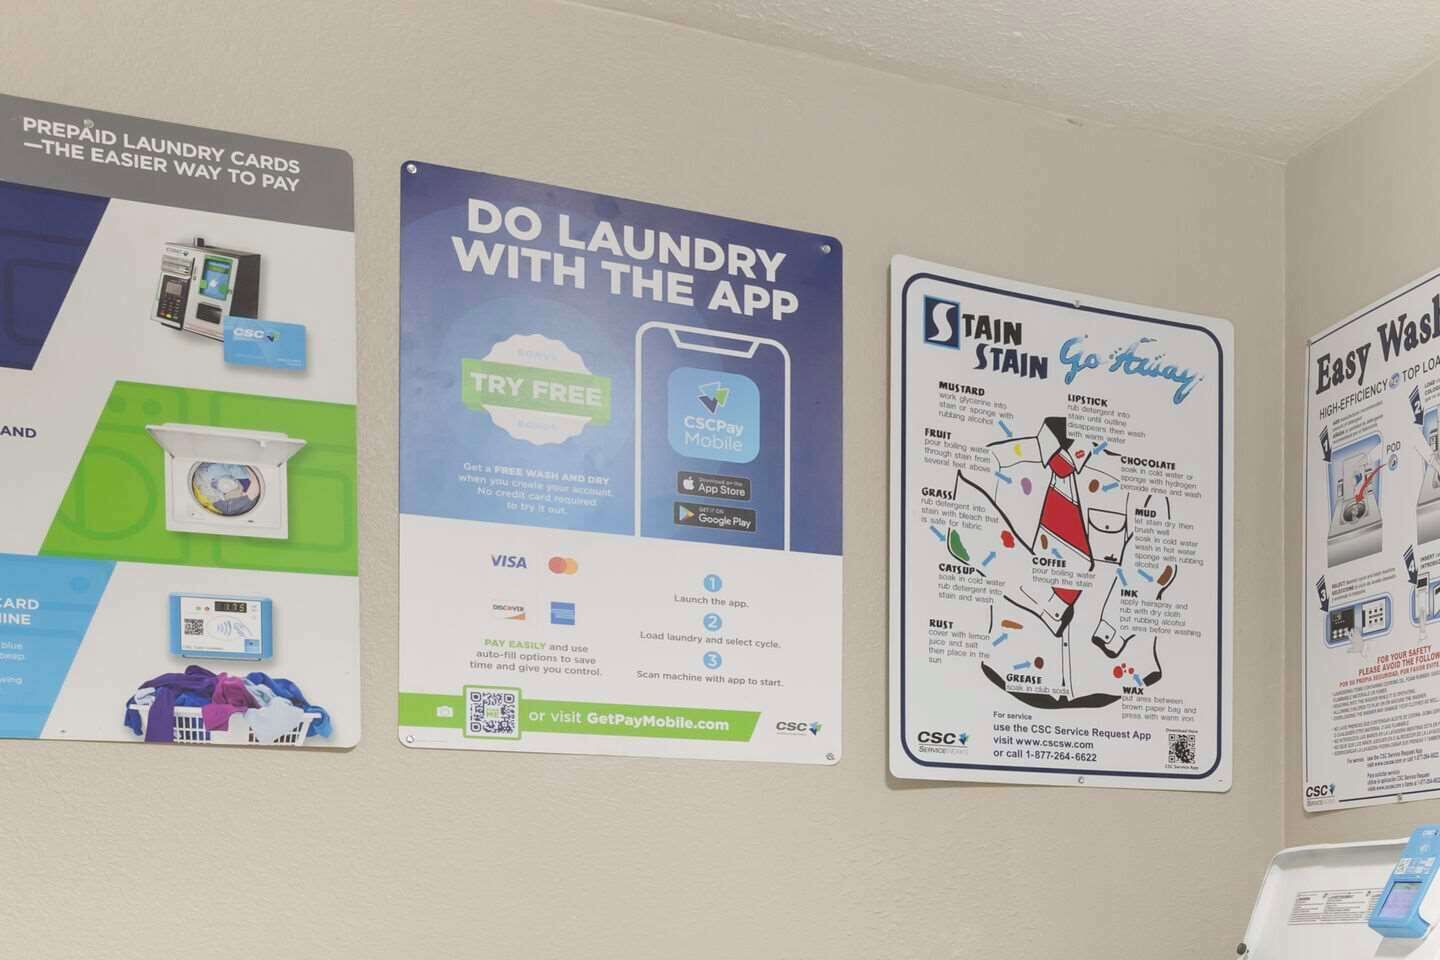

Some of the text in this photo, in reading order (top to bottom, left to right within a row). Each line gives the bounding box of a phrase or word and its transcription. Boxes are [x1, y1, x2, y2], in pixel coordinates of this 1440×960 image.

[23, 116, 300, 174] PREPAID LAUNDRY CARDS
[91, 146, 167, 173] EASIER
[174, 160, 221, 181] WAY
[227, 168, 257, 186] TO
[262, 174, 300, 192] PAY
[468, 197, 787, 283] DO LAUNDRY
[451, 236, 799, 321] WITH THE APP
[233, 327, 265, 339] CSC
[972, 343, 1049, 380] STAIN
[1058, 334, 1100, 385] Go
[1316, 342, 1371, 395] Easy
[470, 371, 603, 406] TRY FREE
[938, 381, 985, 396] MUSTARD
[1319, 381, 1389, 420] HIGH-EFFICIENCY
[1403, 363, 1420, 383] TOP
[1068, 394, 1108, 407] LIPSTICK
[0, 426, 37, 439] AND
[684, 415, 744, 437] CSCPay
[924, 428, 952, 439] FRUIT
[684, 432, 743, 451] Mobile
[1120, 456, 1175, 470] CHOCOLATE
[698, 484, 746, 497] App Store
[922, 487, 952, 500] GRASS
[1135, 508, 1157, 518] MUD
[698, 513, 751, 529] Google Play
[491, 555, 528, 569] VISA
[938, 563, 976, 575] CATSUP
[1032, 557, 1066, 568] COFFEE
[1120, 589, 1139, 598] INK
[674, 594, 750, 609] Launch the app.
[708, 617, 718, 629] 2
[929, 619, 954, 629] RUST
[484, 639, 505, 647] PAY
[509, 640, 545, 650] EASILY
[549, 643, 568, 653] and
[640, 631, 781, 649] Load laundry and select cycle.
[708, 654, 718, 667] 3
[1377, 645, 1432, 664] FOR YOUR SAFETY
[1358, 664, 1381, 676] PLEASE
[1383, 661, 1400, 671] AVOID
[1402, 657, 1414, 667] THE
[636, 671, 784, 687] Scan machine with app to start.
[1006, 673, 1042, 685] GREASE
[1122, 686, 1144, 695] WAX
[529, 711, 730, 732] or visit GetPayMobile.com
[993, 711, 1032, 722] For service
[776, 721, 808, 732] CSC
[993, 723, 1152, 741] use the CSC Service Request App
[917, 731, 957, 745] CSC
[993, 736, 1094, 749] visit www.cscsw.com
[1006, 749, 1024, 760] call
[1026, 750, 1097, 763] 1-877-264-6622
[1306, 785, 1328, 798] CSC
